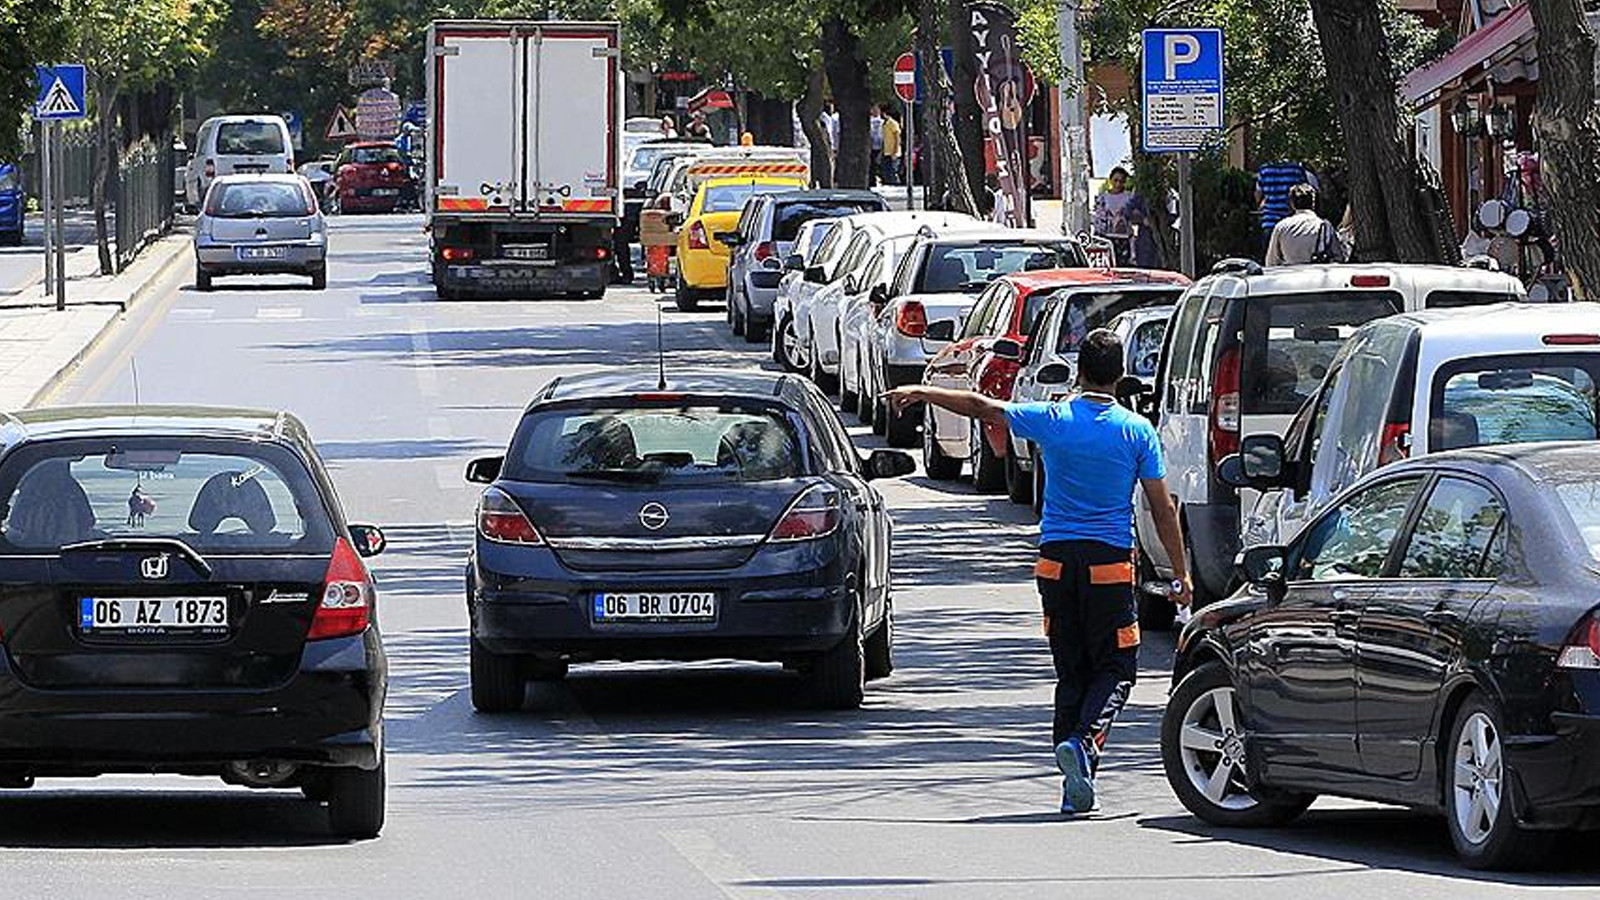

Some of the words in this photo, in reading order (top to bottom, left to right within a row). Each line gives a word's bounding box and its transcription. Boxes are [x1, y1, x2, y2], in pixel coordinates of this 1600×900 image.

[1164, 34, 1201, 80] P
[96, 600, 121, 623] 06
[136, 600, 161, 623] AZ
[175, 600, 225, 623] 1873
[606, 595, 627, 614] 06
[639, 595, 660, 614] BR
[669, 594, 712, 614] 0704
